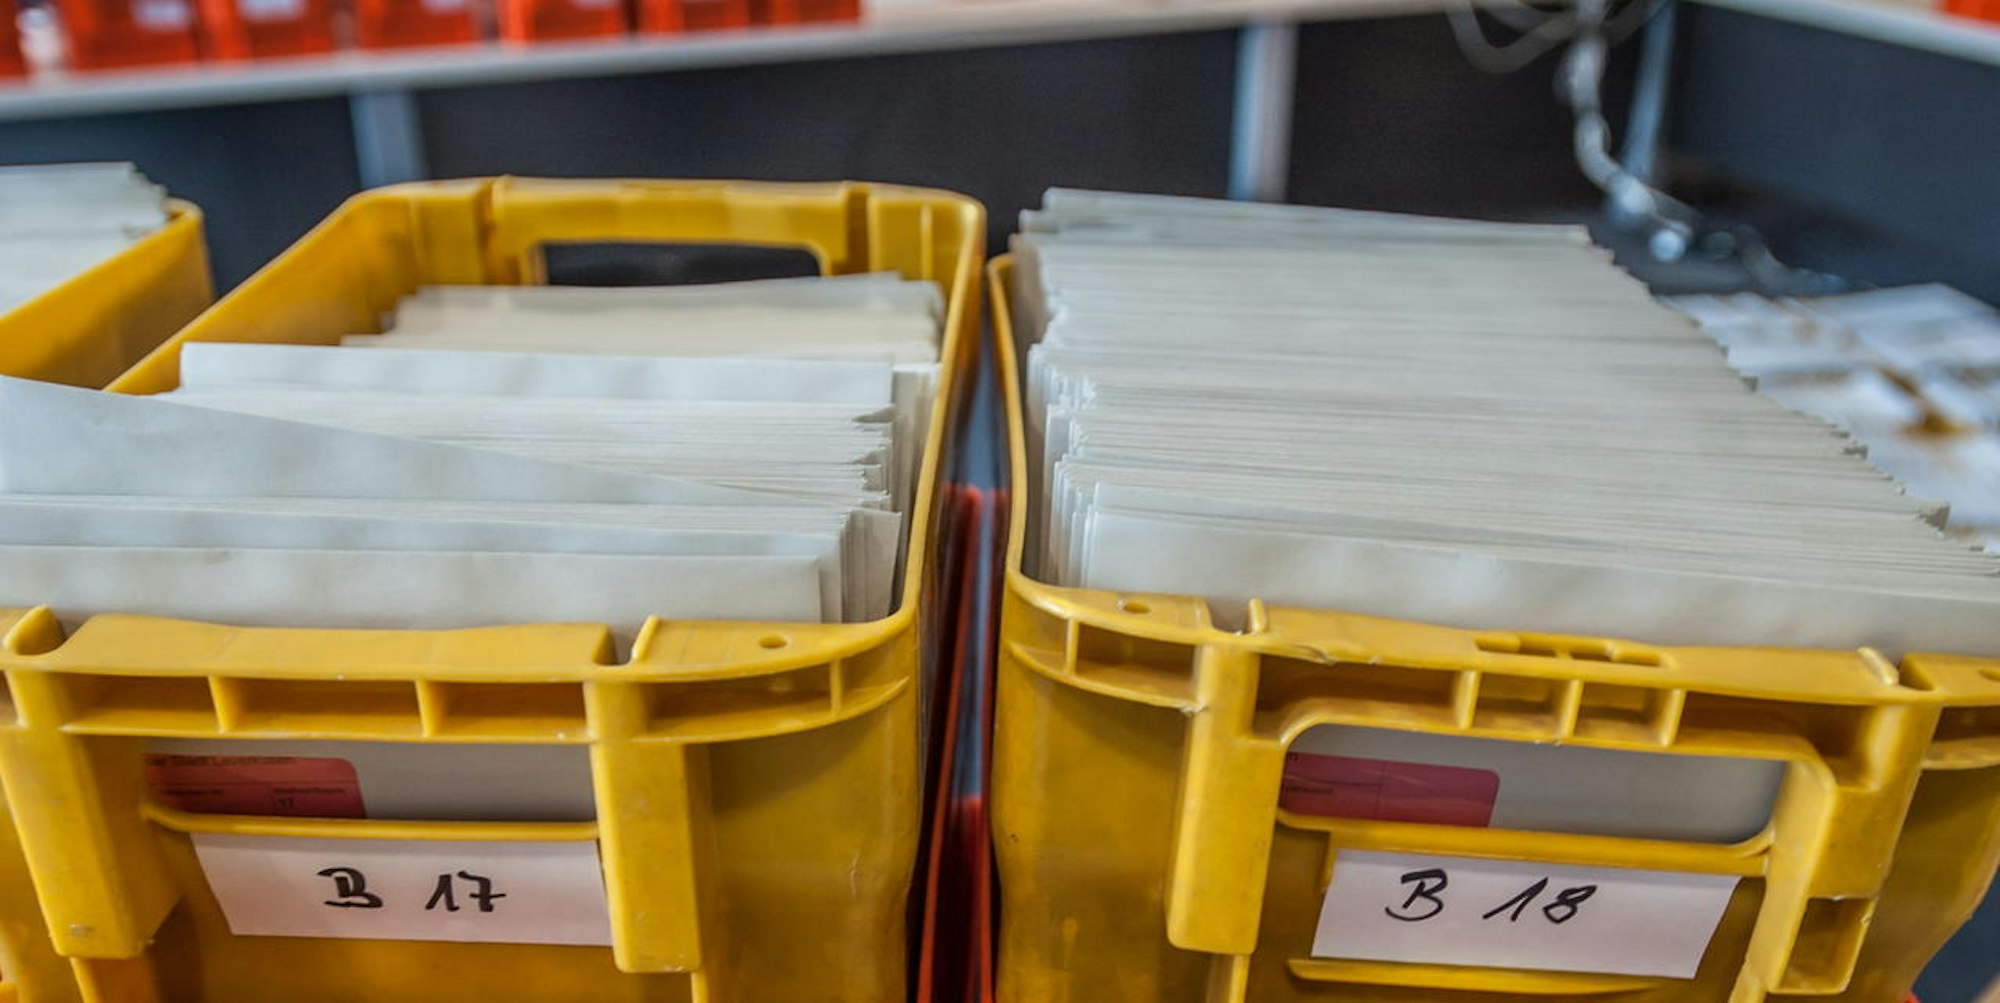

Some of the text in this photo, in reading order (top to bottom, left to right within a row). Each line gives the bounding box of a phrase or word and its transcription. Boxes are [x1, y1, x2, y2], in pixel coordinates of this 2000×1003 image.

[316, 868, 507, 913] B 17
[1385, 869, 1597, 925] B 18
